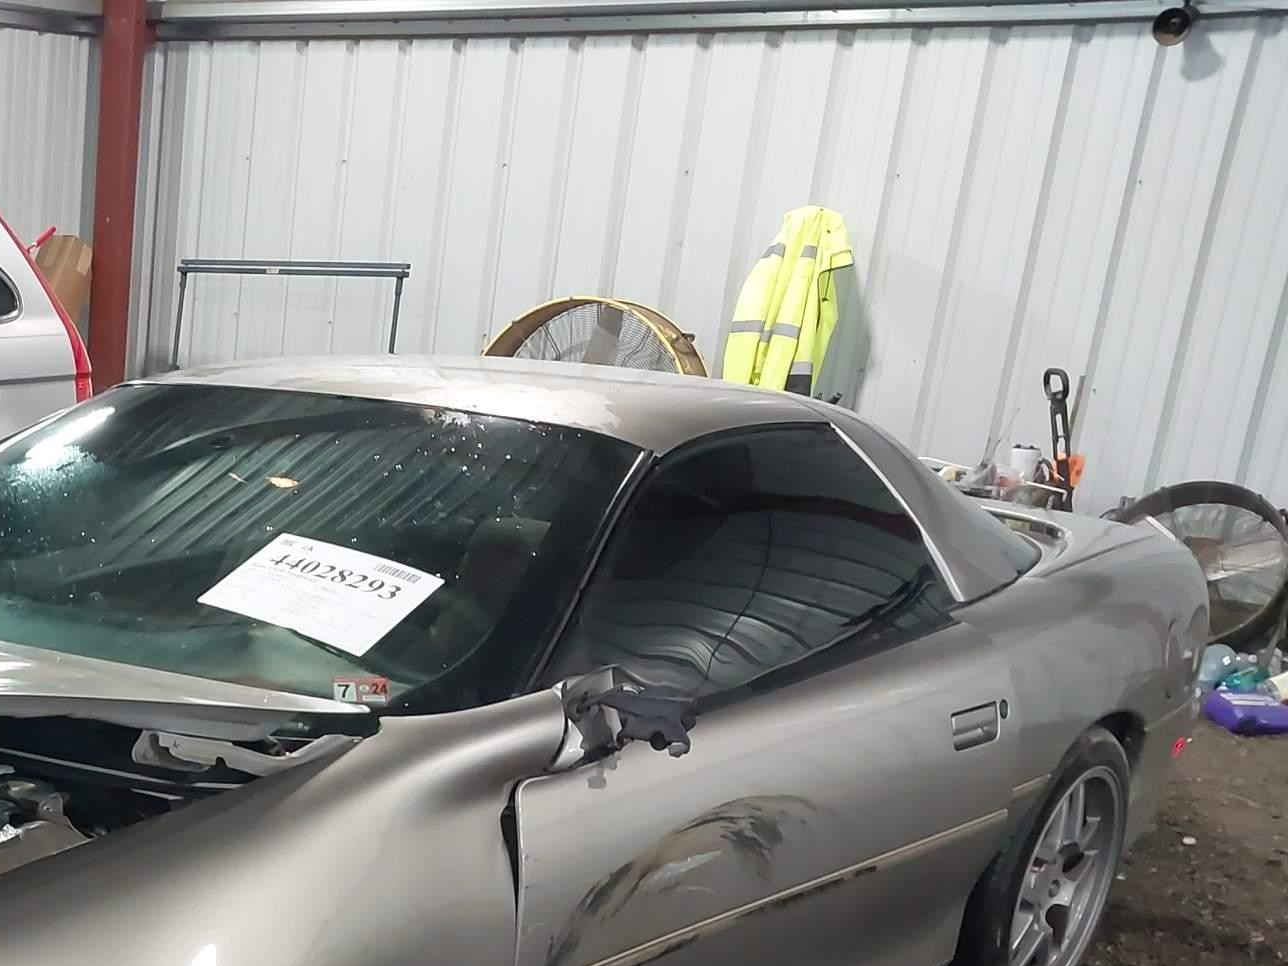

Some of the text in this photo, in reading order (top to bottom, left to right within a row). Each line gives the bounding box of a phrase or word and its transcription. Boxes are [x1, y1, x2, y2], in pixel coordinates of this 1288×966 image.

[268, 552, 403, 601] 44028293
[337, 682, 388, 699] 7 24
